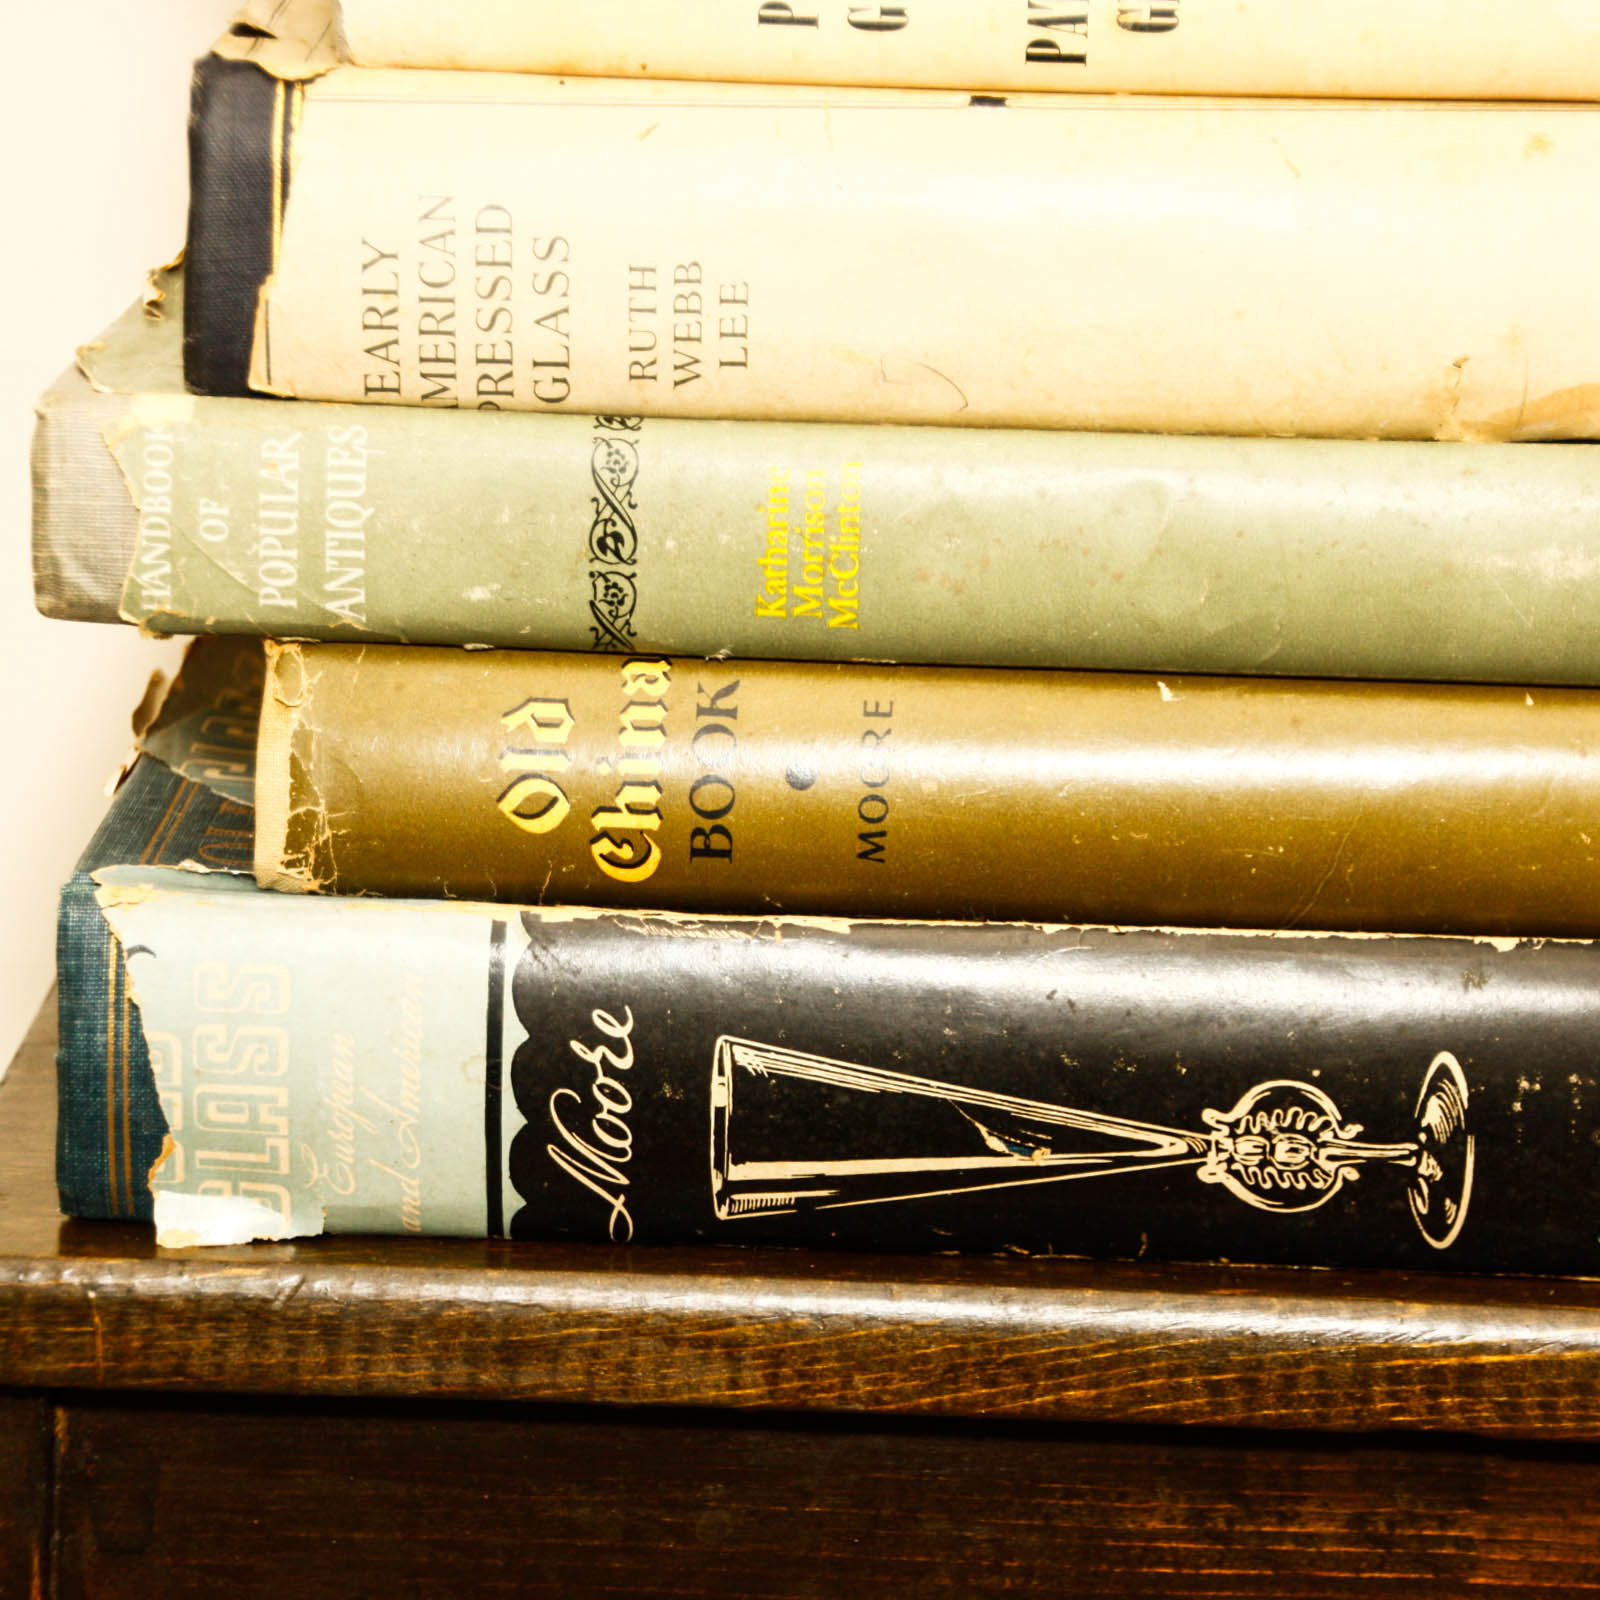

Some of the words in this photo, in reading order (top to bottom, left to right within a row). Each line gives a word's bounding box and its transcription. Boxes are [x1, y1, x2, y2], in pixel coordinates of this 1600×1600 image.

[1024, 0, 1089, 66] PA
[1116, 0, 1181, 33] G
[362, 236, 401, 397] EARLY
[418, 193, 459, 408] MERICAN
[531, 234, 571, 404] GLASS
[628, 263, 658, 384] RUTH
[672, 260, 702, 390] WEBB
[718, 280, 749, 370] LEE
[199, 497, 231, 543] OF
[257, 431, 301, 610] POPULAR
[321, 424, 376, 624] ANTIQUES
[756, 464, 790, 619] Katharine
[791, 468, 825, 619] Morrison
[826, 460, 862, 631] McClinton
[497, 697, 575, 834] Old
[590, 656, 671, 883] China
[689, 679, 740, 864] BOOK
[856, 700, 894, 864] MOORE
[360, 975, 423, 1169] American
[547, 1004, 634, 1242] Moore
[369, 1176, 422, 1233] and
